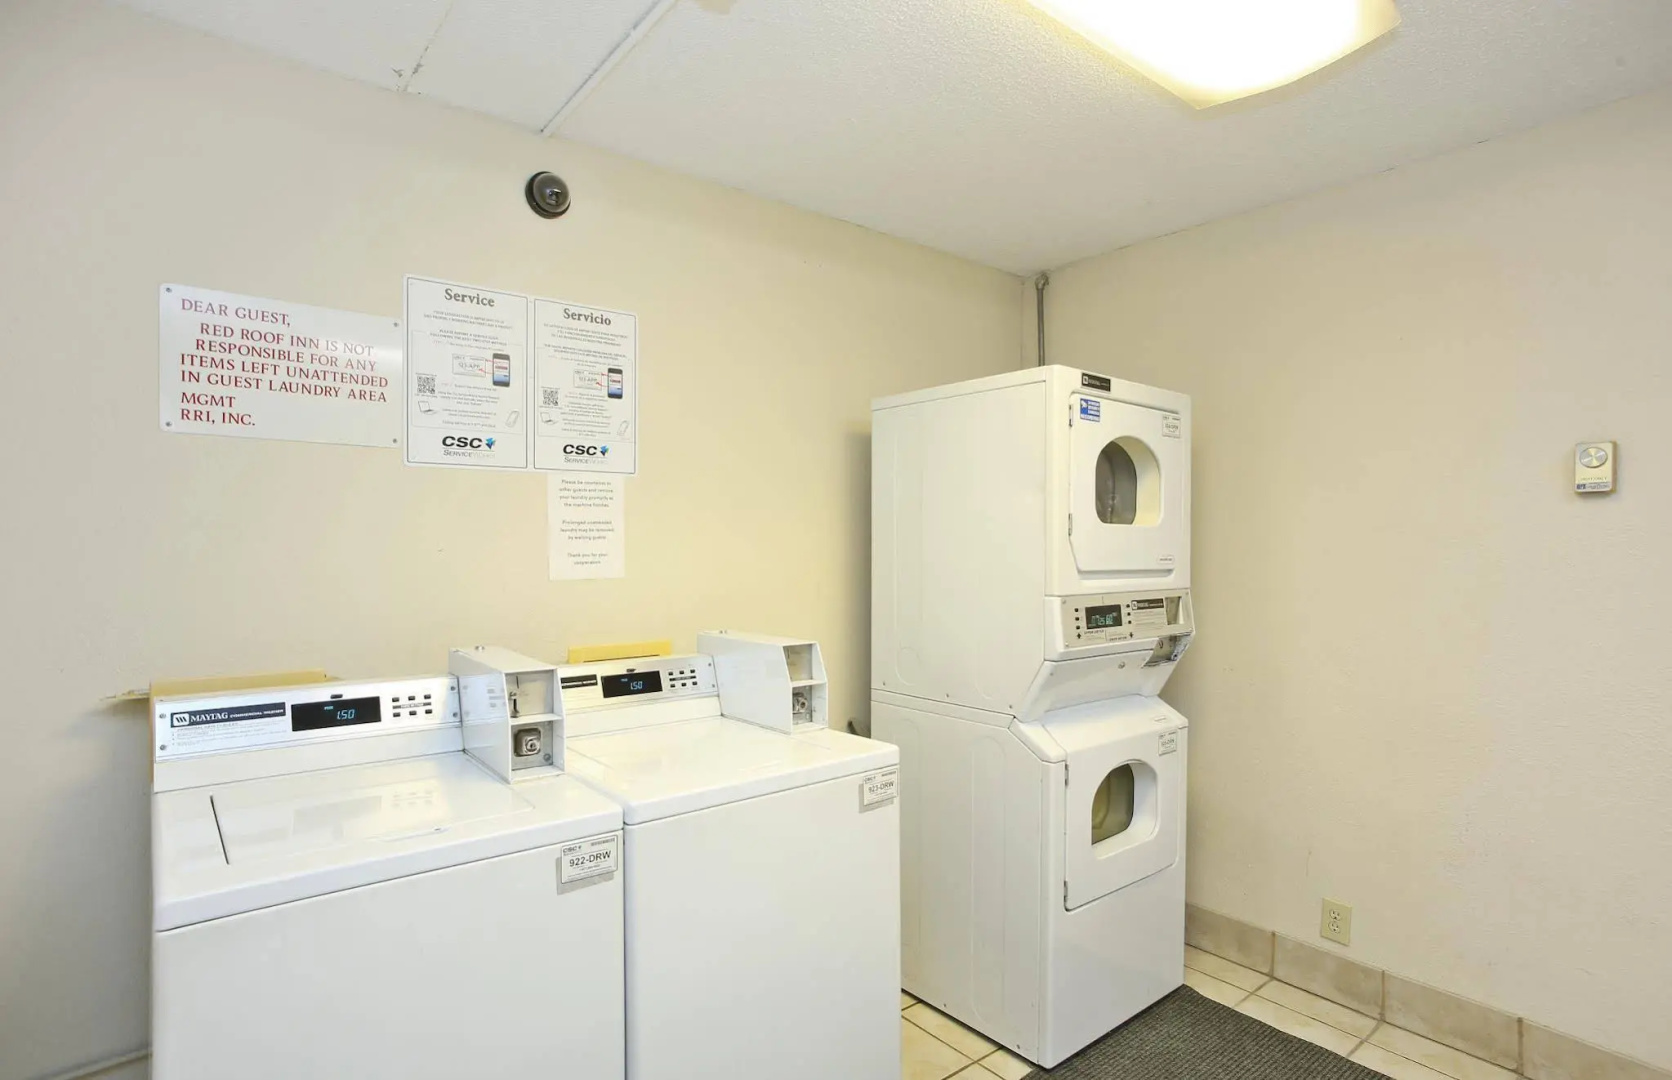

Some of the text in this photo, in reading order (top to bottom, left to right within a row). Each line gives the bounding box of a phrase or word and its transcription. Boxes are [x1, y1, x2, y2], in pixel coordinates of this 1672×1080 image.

[444, 288, 495, 307] Service
[181, 298, 291, 327] DEAR GUEST,
[563, 308, 611, 325] Servicio
[200, 323, 374, 356] RED ROOF INN IS NOT
[196, 339, 377, 372] RESPONSIBLE FOR ANY
[181, 353, 388, 387] ITEMS LEFT UNATTENDED
[181, 370, 387, 402] IN GUEST LAUNDRY AREA
[181, 392, 236, 408] MGMT
[180, 408, 256, 426] RRI, INC.
[442, 436, 482, 449] CSC
[563, 444, 597, 455] CSC
[190, 712, 228, 722] MAYTAG
[569, 850, 611, 867] 922-DRW
